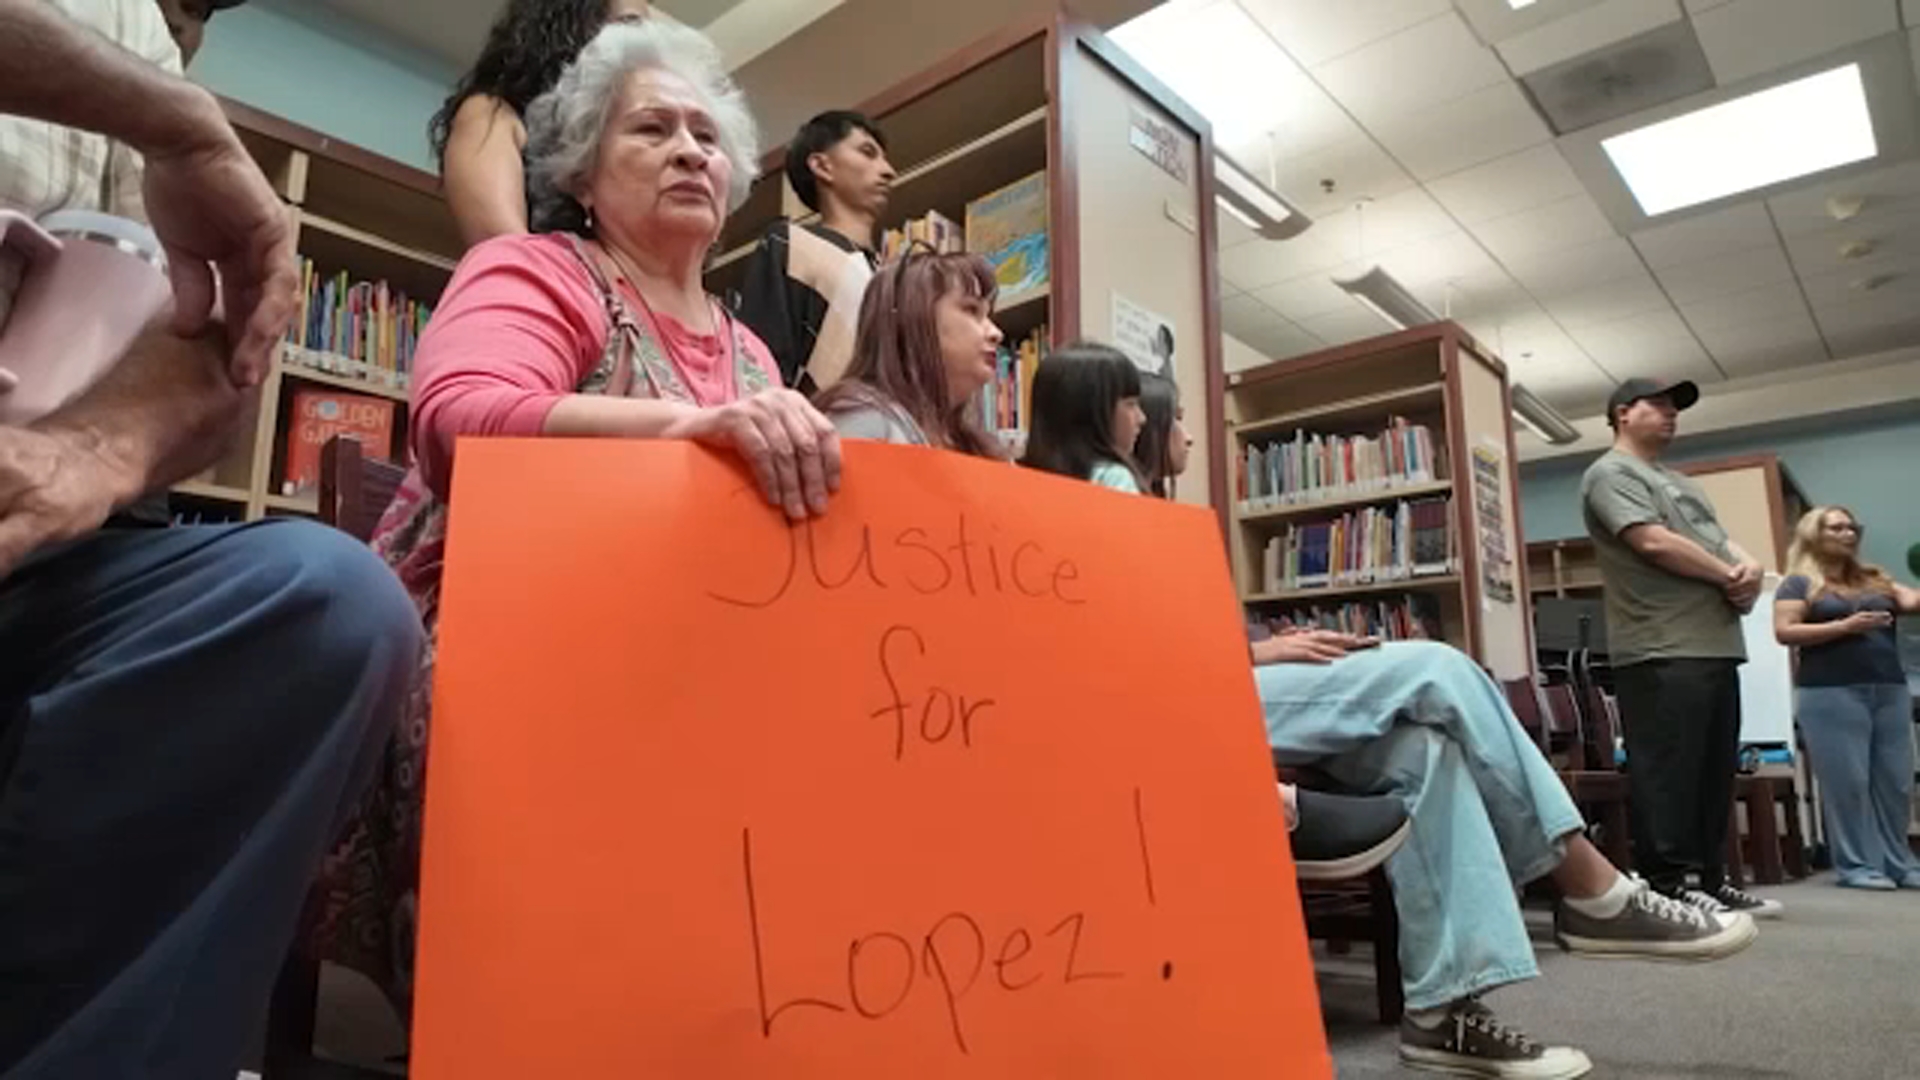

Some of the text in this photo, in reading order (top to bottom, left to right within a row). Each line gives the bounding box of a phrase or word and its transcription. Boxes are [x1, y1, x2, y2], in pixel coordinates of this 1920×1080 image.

[303, 396, 386, 429] GOLDEN
[707, 486, 1087, 608] Justice
[869, 625, 996, 761] for
[743, 786, 1174, 1053] Lopez!
